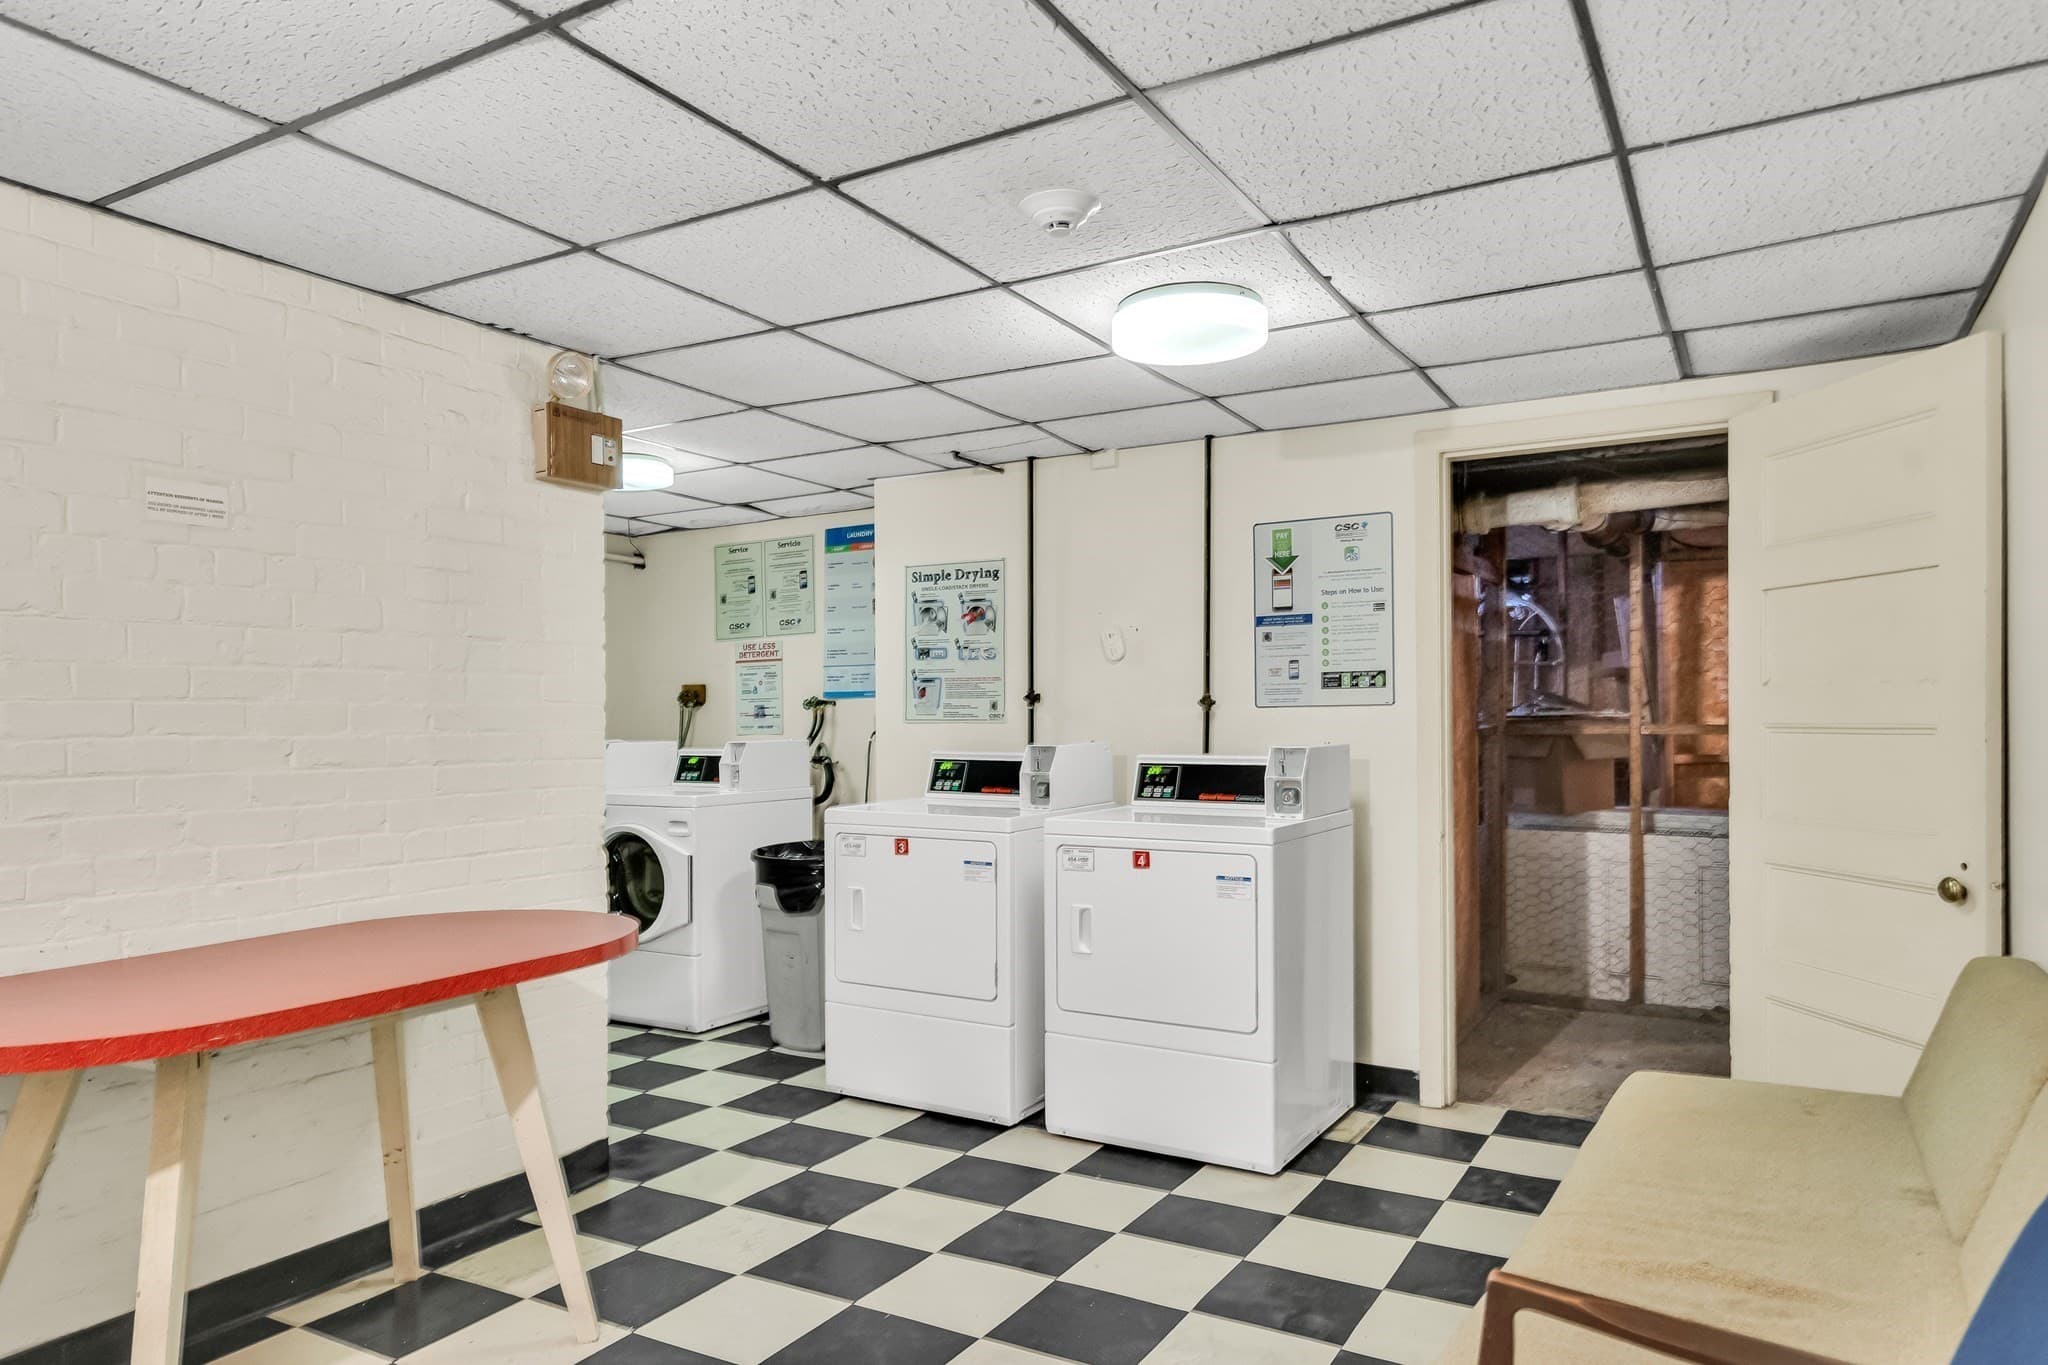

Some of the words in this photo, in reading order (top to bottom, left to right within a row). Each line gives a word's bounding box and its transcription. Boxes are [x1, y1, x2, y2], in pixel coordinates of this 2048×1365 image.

[1335, 523, 1360, 531] CSC
[847, 530, 873, 539] LAUNDRY
[1275, 532, 1288, 540] PAY
[777, 541, 801, 549] Servicio
[728, 547, 748, 555] Service
[911, 570, 951, 585] Simple
[955, 568, 1000, 583] Drying
[1321, 589, 1338, 597] Steps
[729, 623, 745, 631] CSC
[743, 643, 757, 651] USE
[758, 642, 776, 650] LESS
[739, 650, 779, 659] DETERGENT
[898, 843, 905, 854] 3
[1137, 855, 1145, 868] 4
